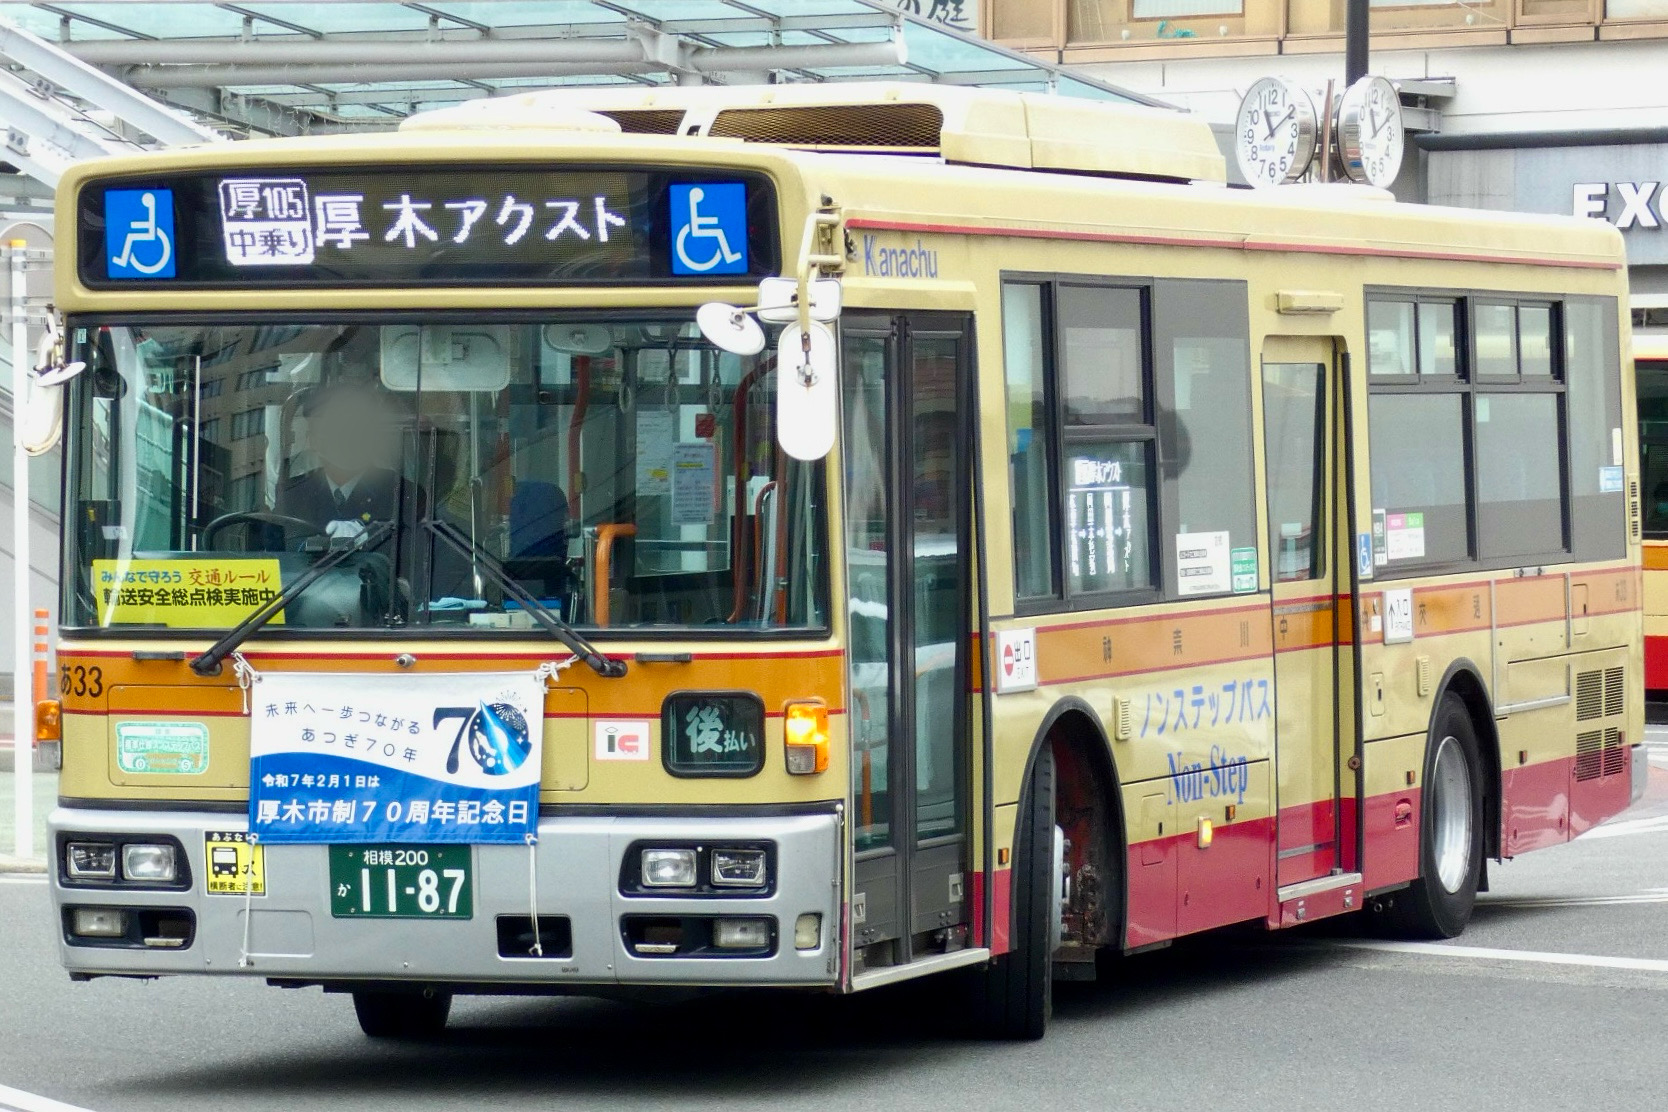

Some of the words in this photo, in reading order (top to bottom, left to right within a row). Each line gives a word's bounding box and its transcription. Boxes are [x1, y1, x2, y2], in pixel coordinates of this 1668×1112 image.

[1268, 89, 1278, 105] 12
[1250, 109, 1260, 125] 10
[1288, 104, 1296, 119] 2
[1247, 129, 1254, 145] 9
[1291, 123, 1298, 138] 3
[228, 184, 302, 219] 厚105
[1573, 182, 1668, 231] EX
[315, 195, 626, 249] 厚木アクスト
[229, 229, 308, 257] 中乗り
[863, 234, 938, 279] Kanachu
[188, 568, 271, 587] 交通ルール
[103, 587, 276, 606] 輸送安全総点検実施中
[1014, 640, 1031, 662] 出口
[61, 664, 103, 698] あ33
[265, 701, 420, 735] 未来へ一歩つながる
[1140, 679, 1271, 738] ノンステップバス
[685, 706, 756, 753] 後払い
[301, 728, 417, 762] あつぎ70年
[262, 774, 380, 788] 令和7年2月1日は
[1167, 744, 1249, 805] Non-Step
[256, 800, 528, 825] 厚木市制70周年記念日
[363, 850, 429, 866] 相模200
[336, 883, 352, 898] か
[361, 869, 466, 914] 11-87
